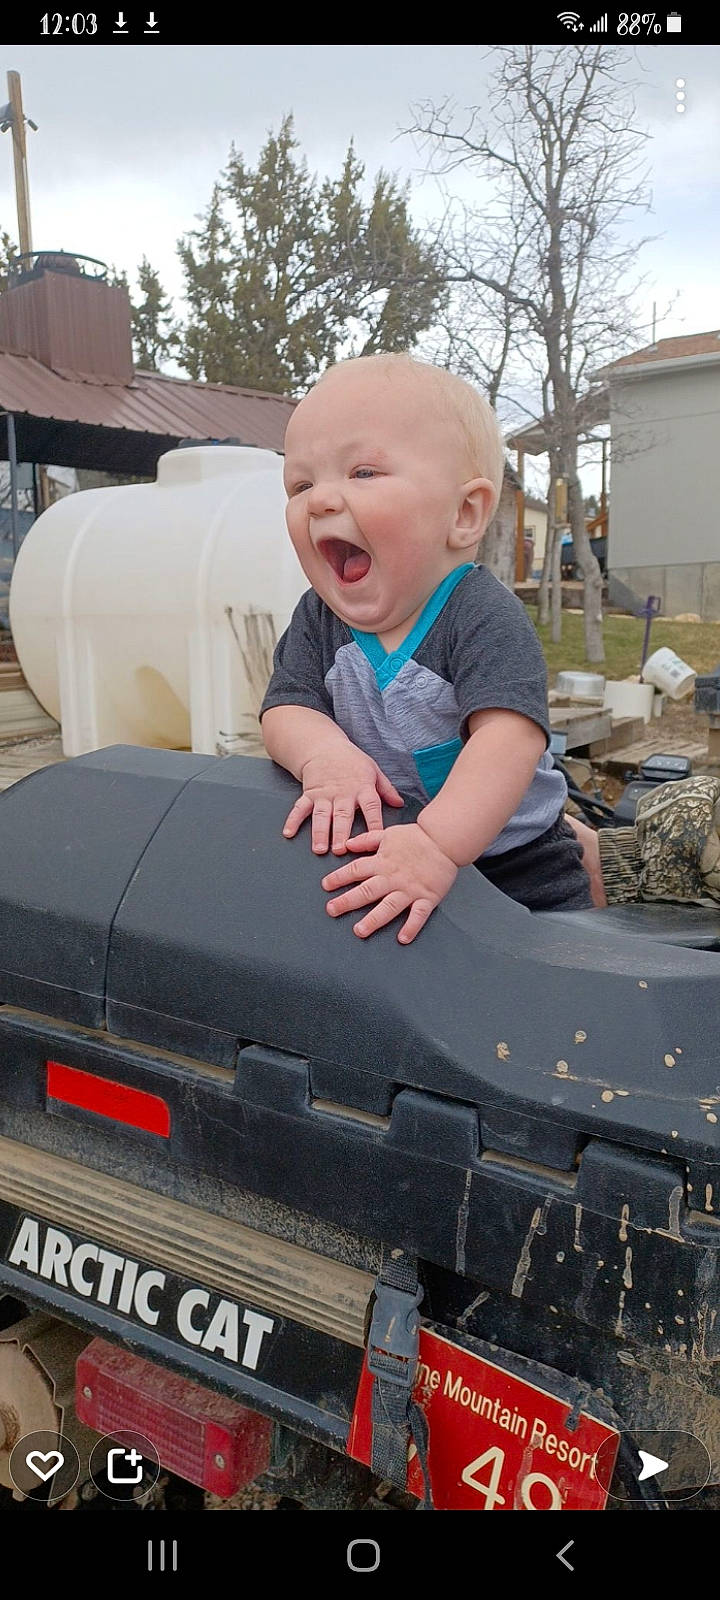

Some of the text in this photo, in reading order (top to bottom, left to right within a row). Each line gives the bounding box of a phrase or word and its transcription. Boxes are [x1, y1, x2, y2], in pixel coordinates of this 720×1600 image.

[8, 1217, 275, 1370] ARCTIC CAT
[413, 1354, 599, 1481] ine Mountain Resort
